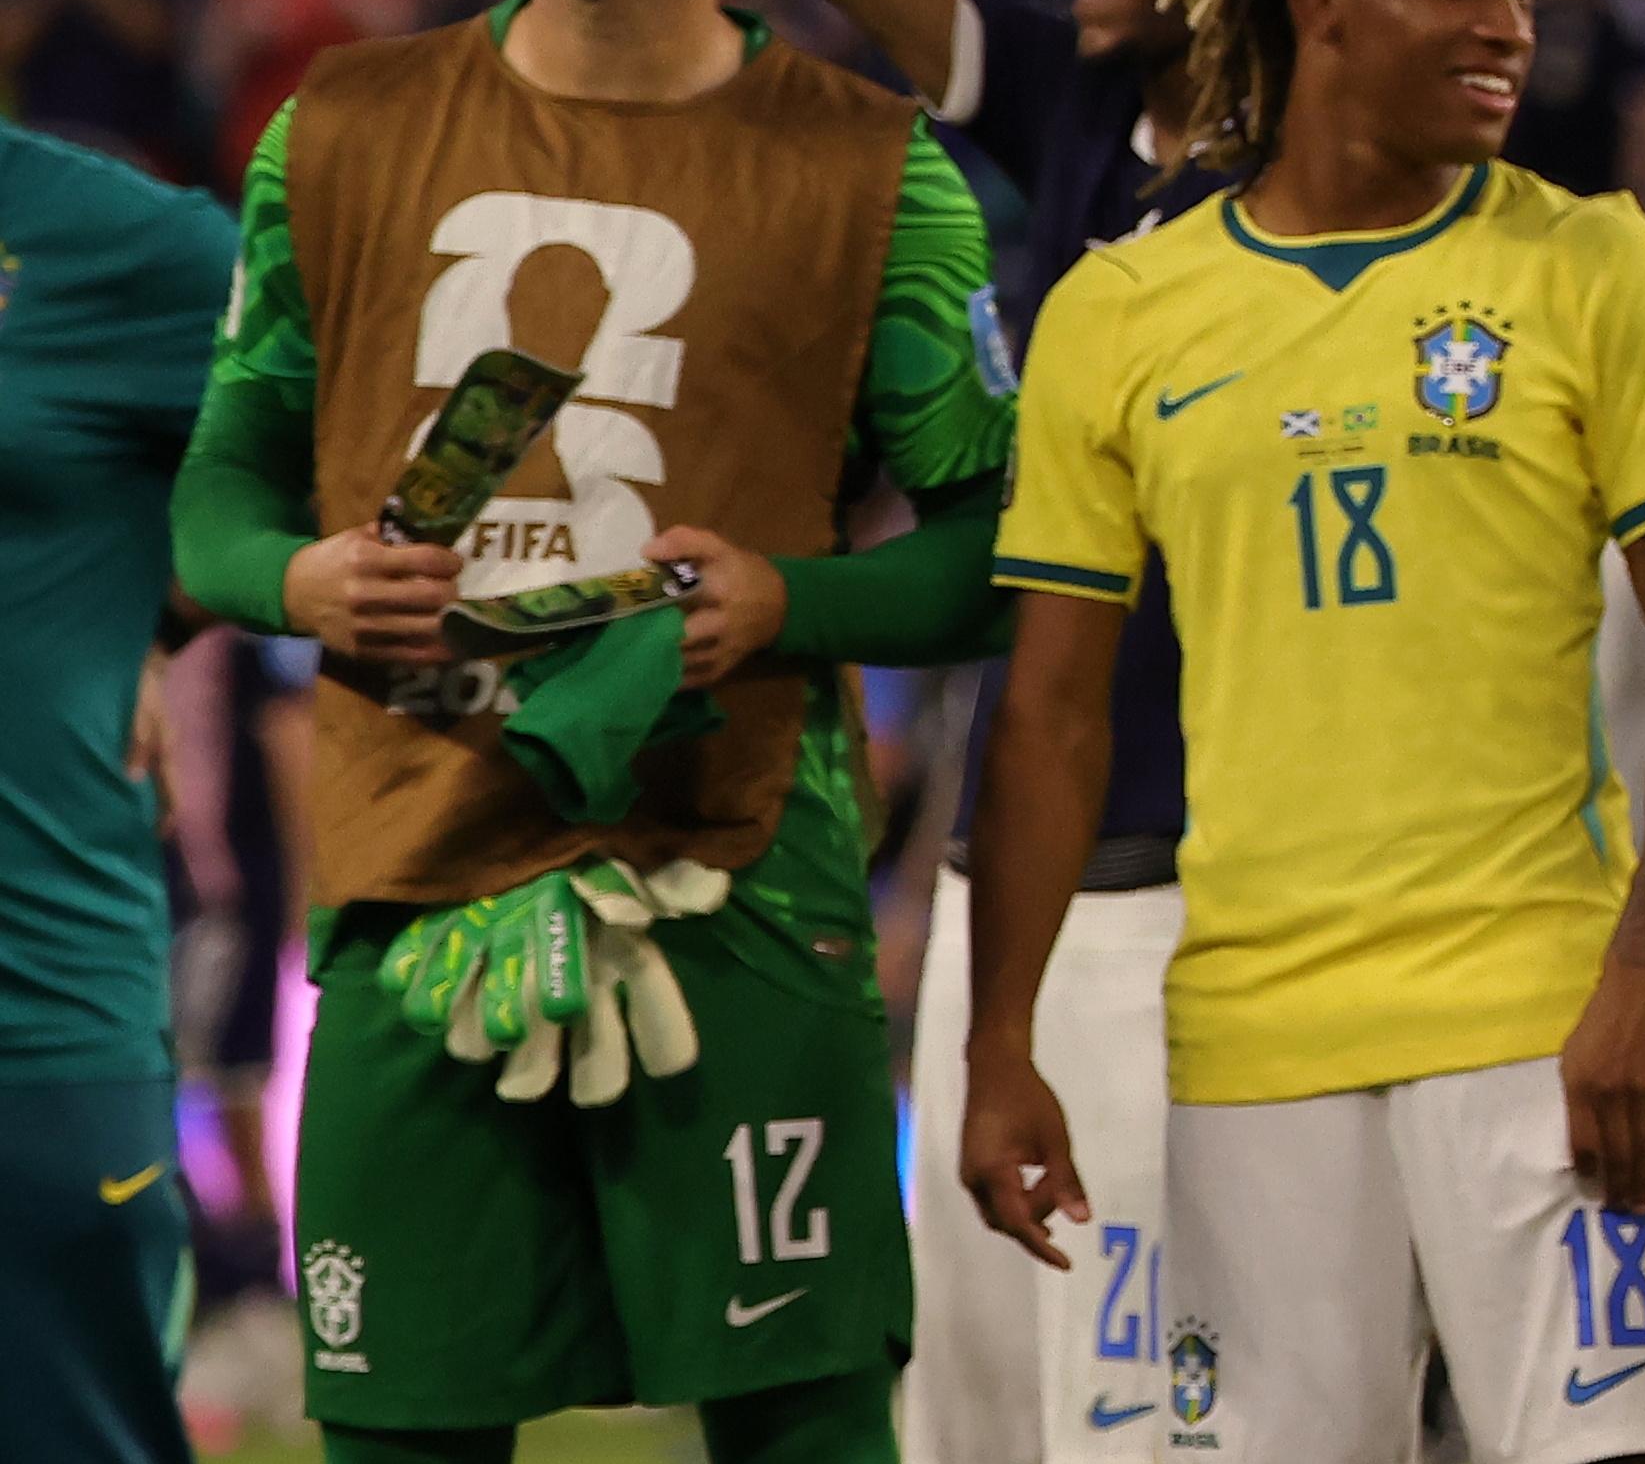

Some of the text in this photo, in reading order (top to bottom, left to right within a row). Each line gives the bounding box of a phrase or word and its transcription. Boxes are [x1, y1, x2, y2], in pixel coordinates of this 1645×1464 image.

[471, 521, 576, 563] FIFA
[1290, 465, 1397, 611] 18
[724, 1116, 830, 1264] 12
